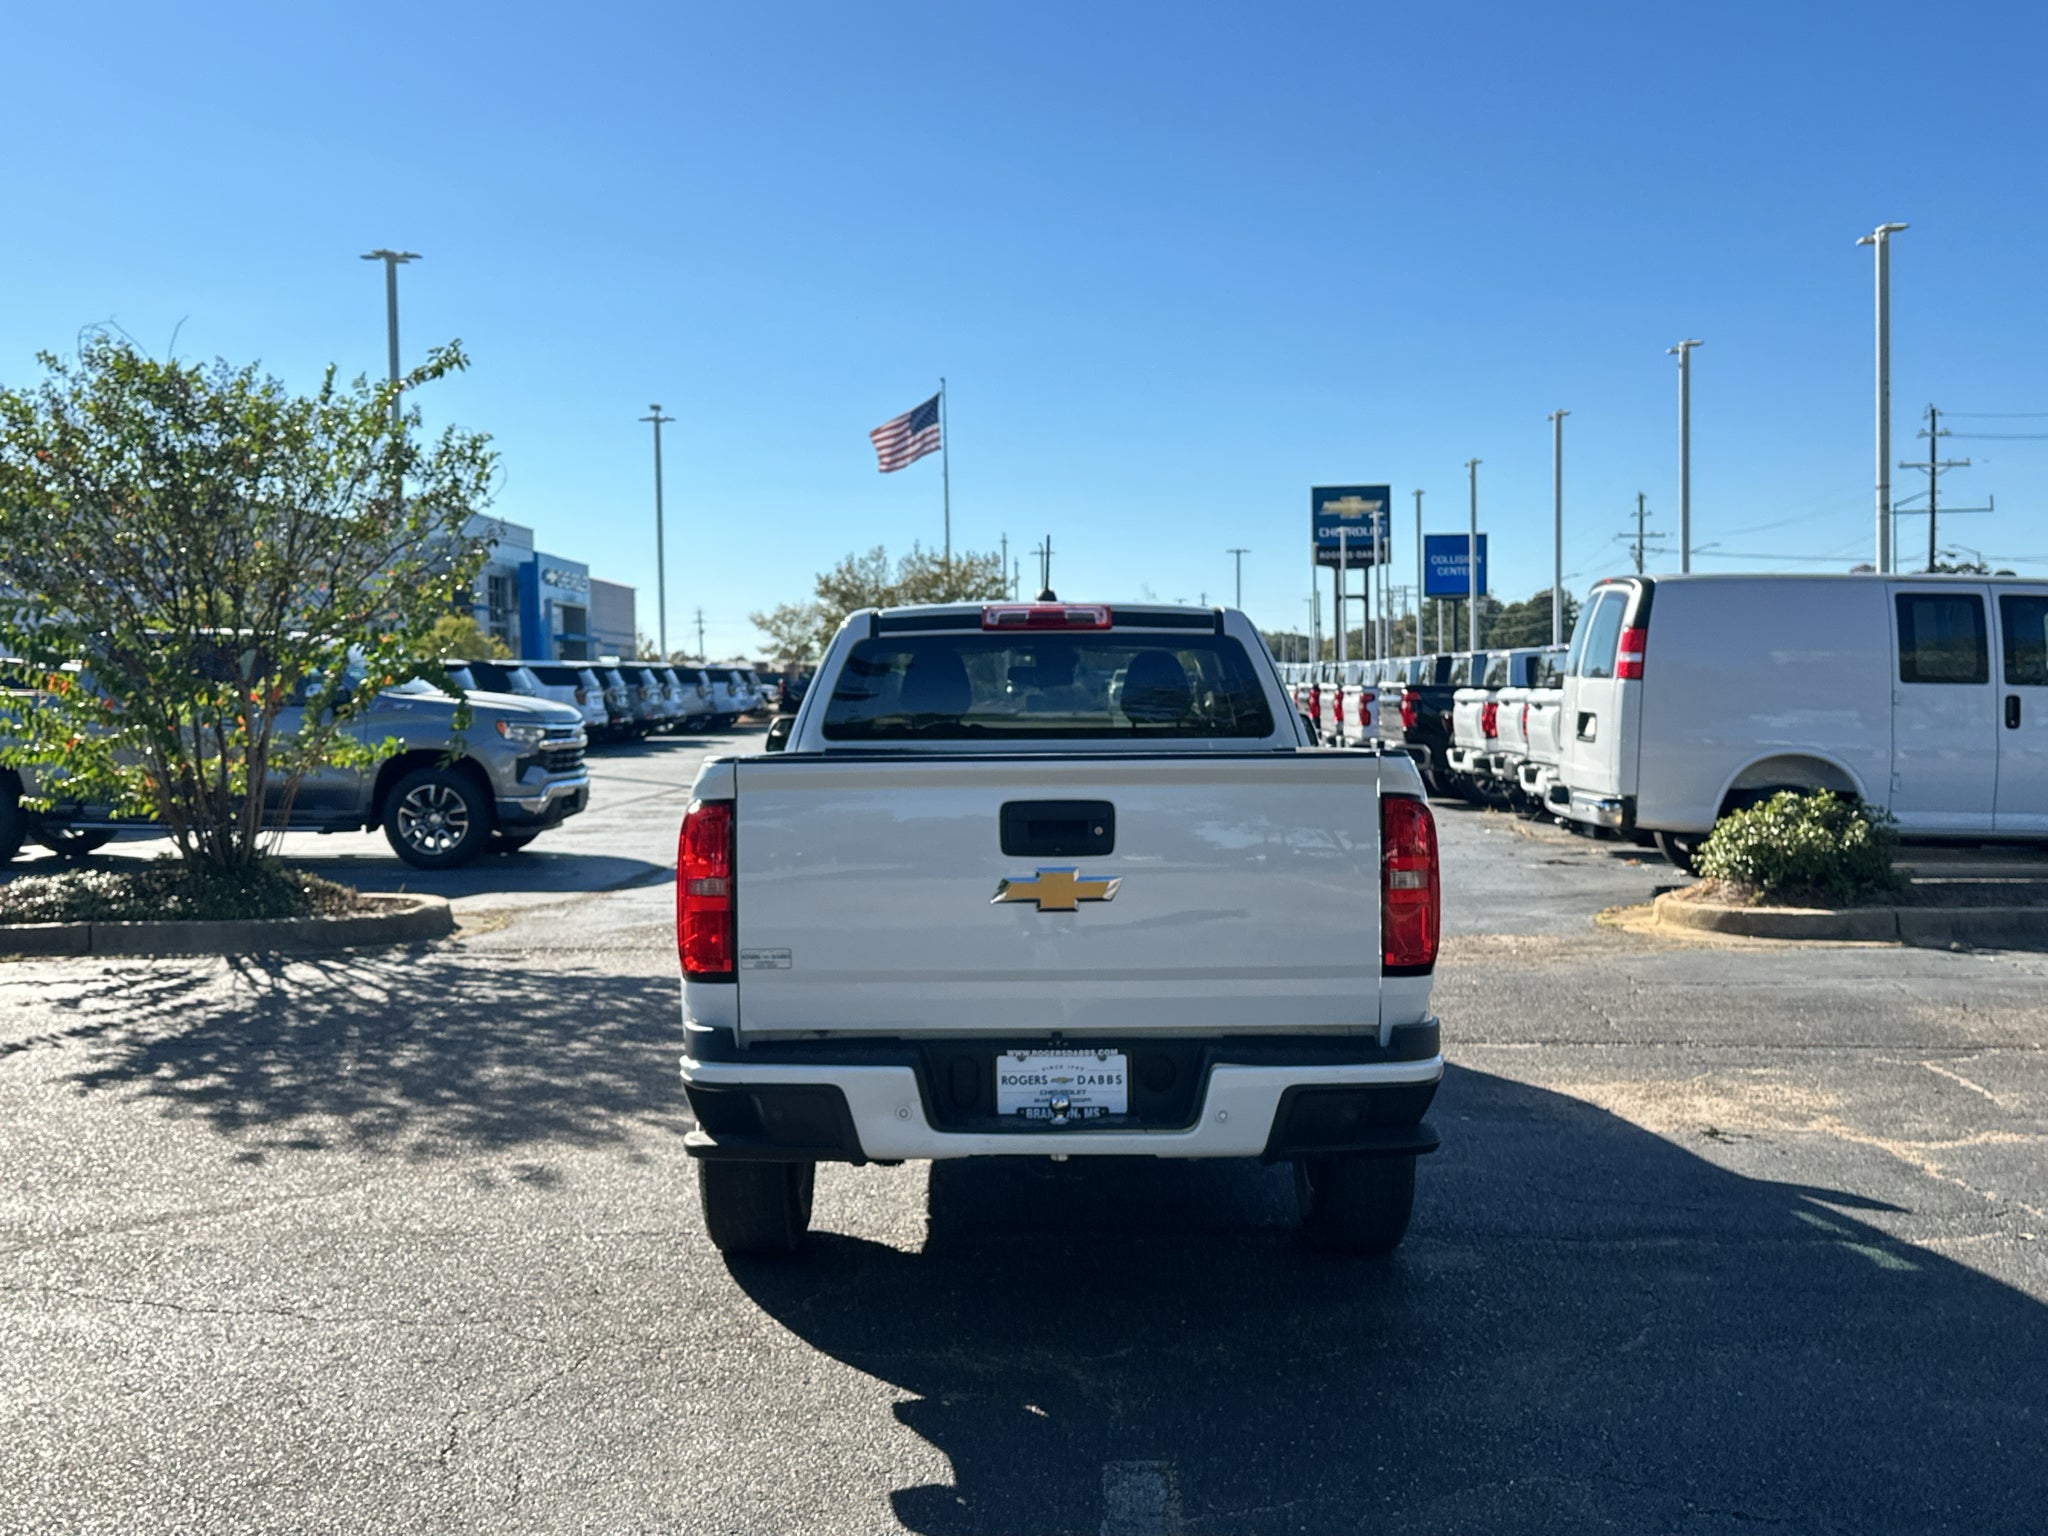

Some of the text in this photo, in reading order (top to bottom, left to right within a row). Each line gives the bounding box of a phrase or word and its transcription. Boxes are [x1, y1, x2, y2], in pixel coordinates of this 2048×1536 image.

[1318, 526, 1383, 538] CHEROL
[1430, 554, 1482, 565] COLLISIN
[1437, 566, 1471, 577] CENTE
[1001, 1074, 1122, 1085] ROGERS DABBS
[1084, 1107, 1101, 1119] MS
